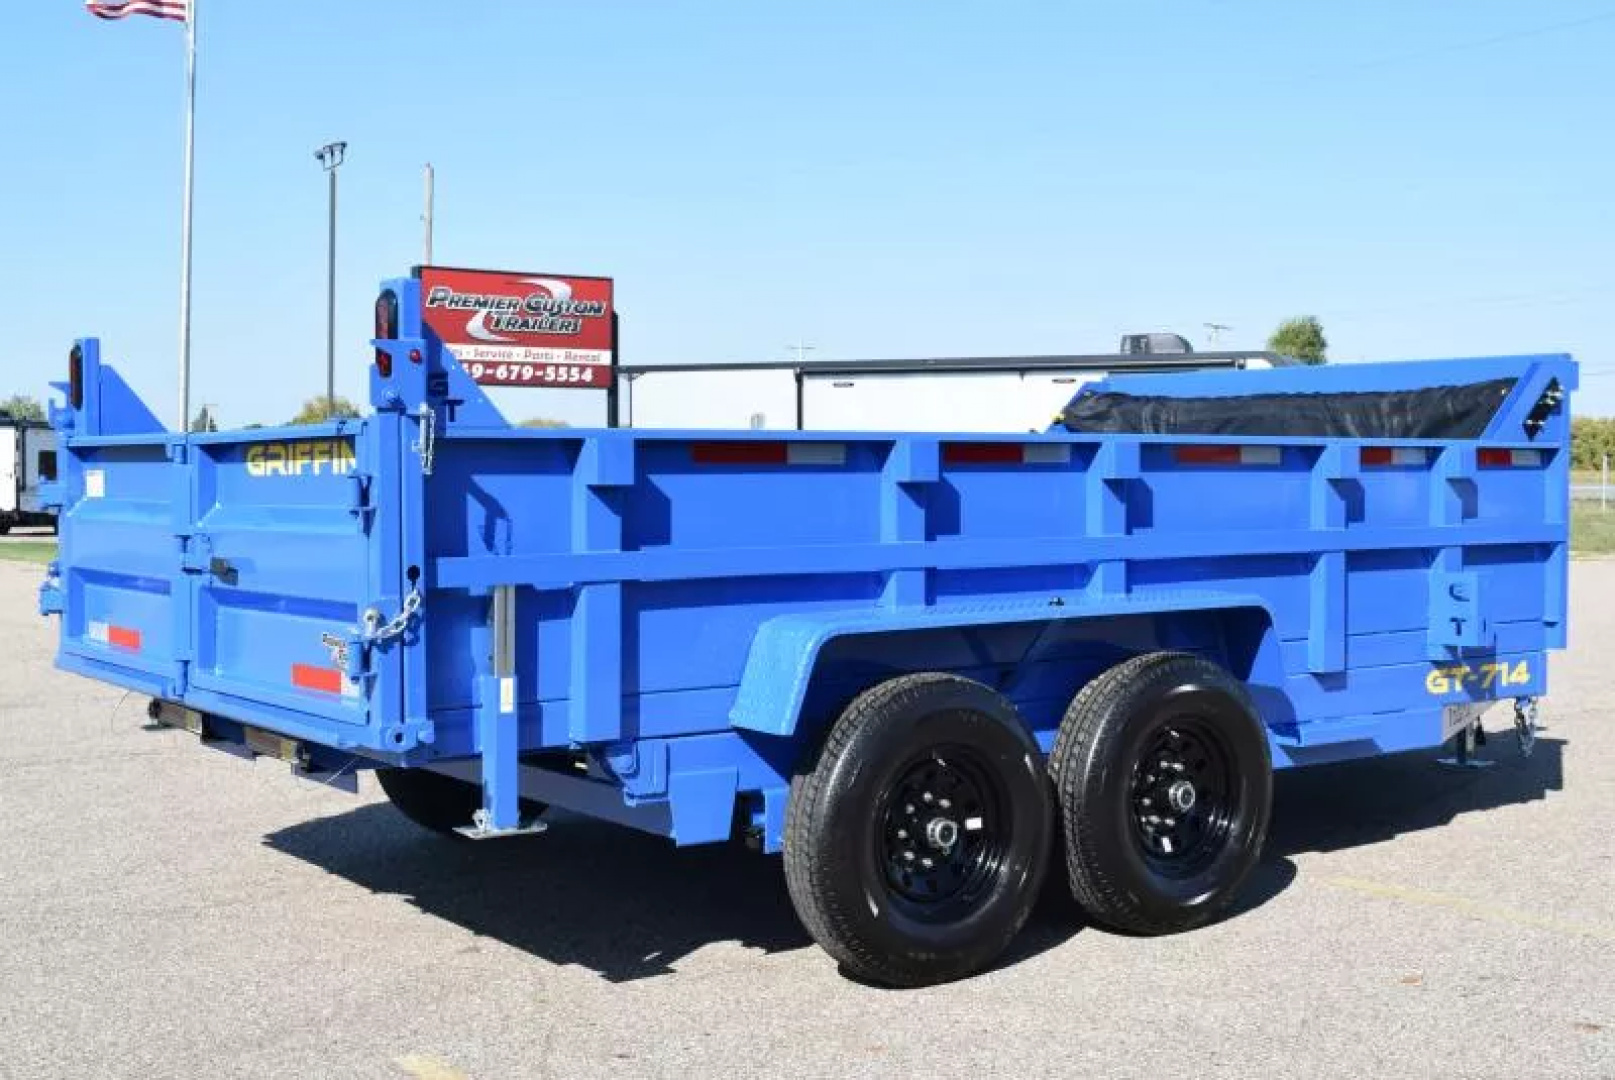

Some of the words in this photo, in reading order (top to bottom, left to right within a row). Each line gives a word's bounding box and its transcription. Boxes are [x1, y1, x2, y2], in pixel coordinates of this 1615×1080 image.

[427, 286, 522, 310] PREMIER
[524, 293, 606, 317] CUSTOM
[491, 314, 582, 334] TRAILERS
[247, 440, 356, 477] GRIFFIN
[1426, 660, 1531, 694] GT-714
